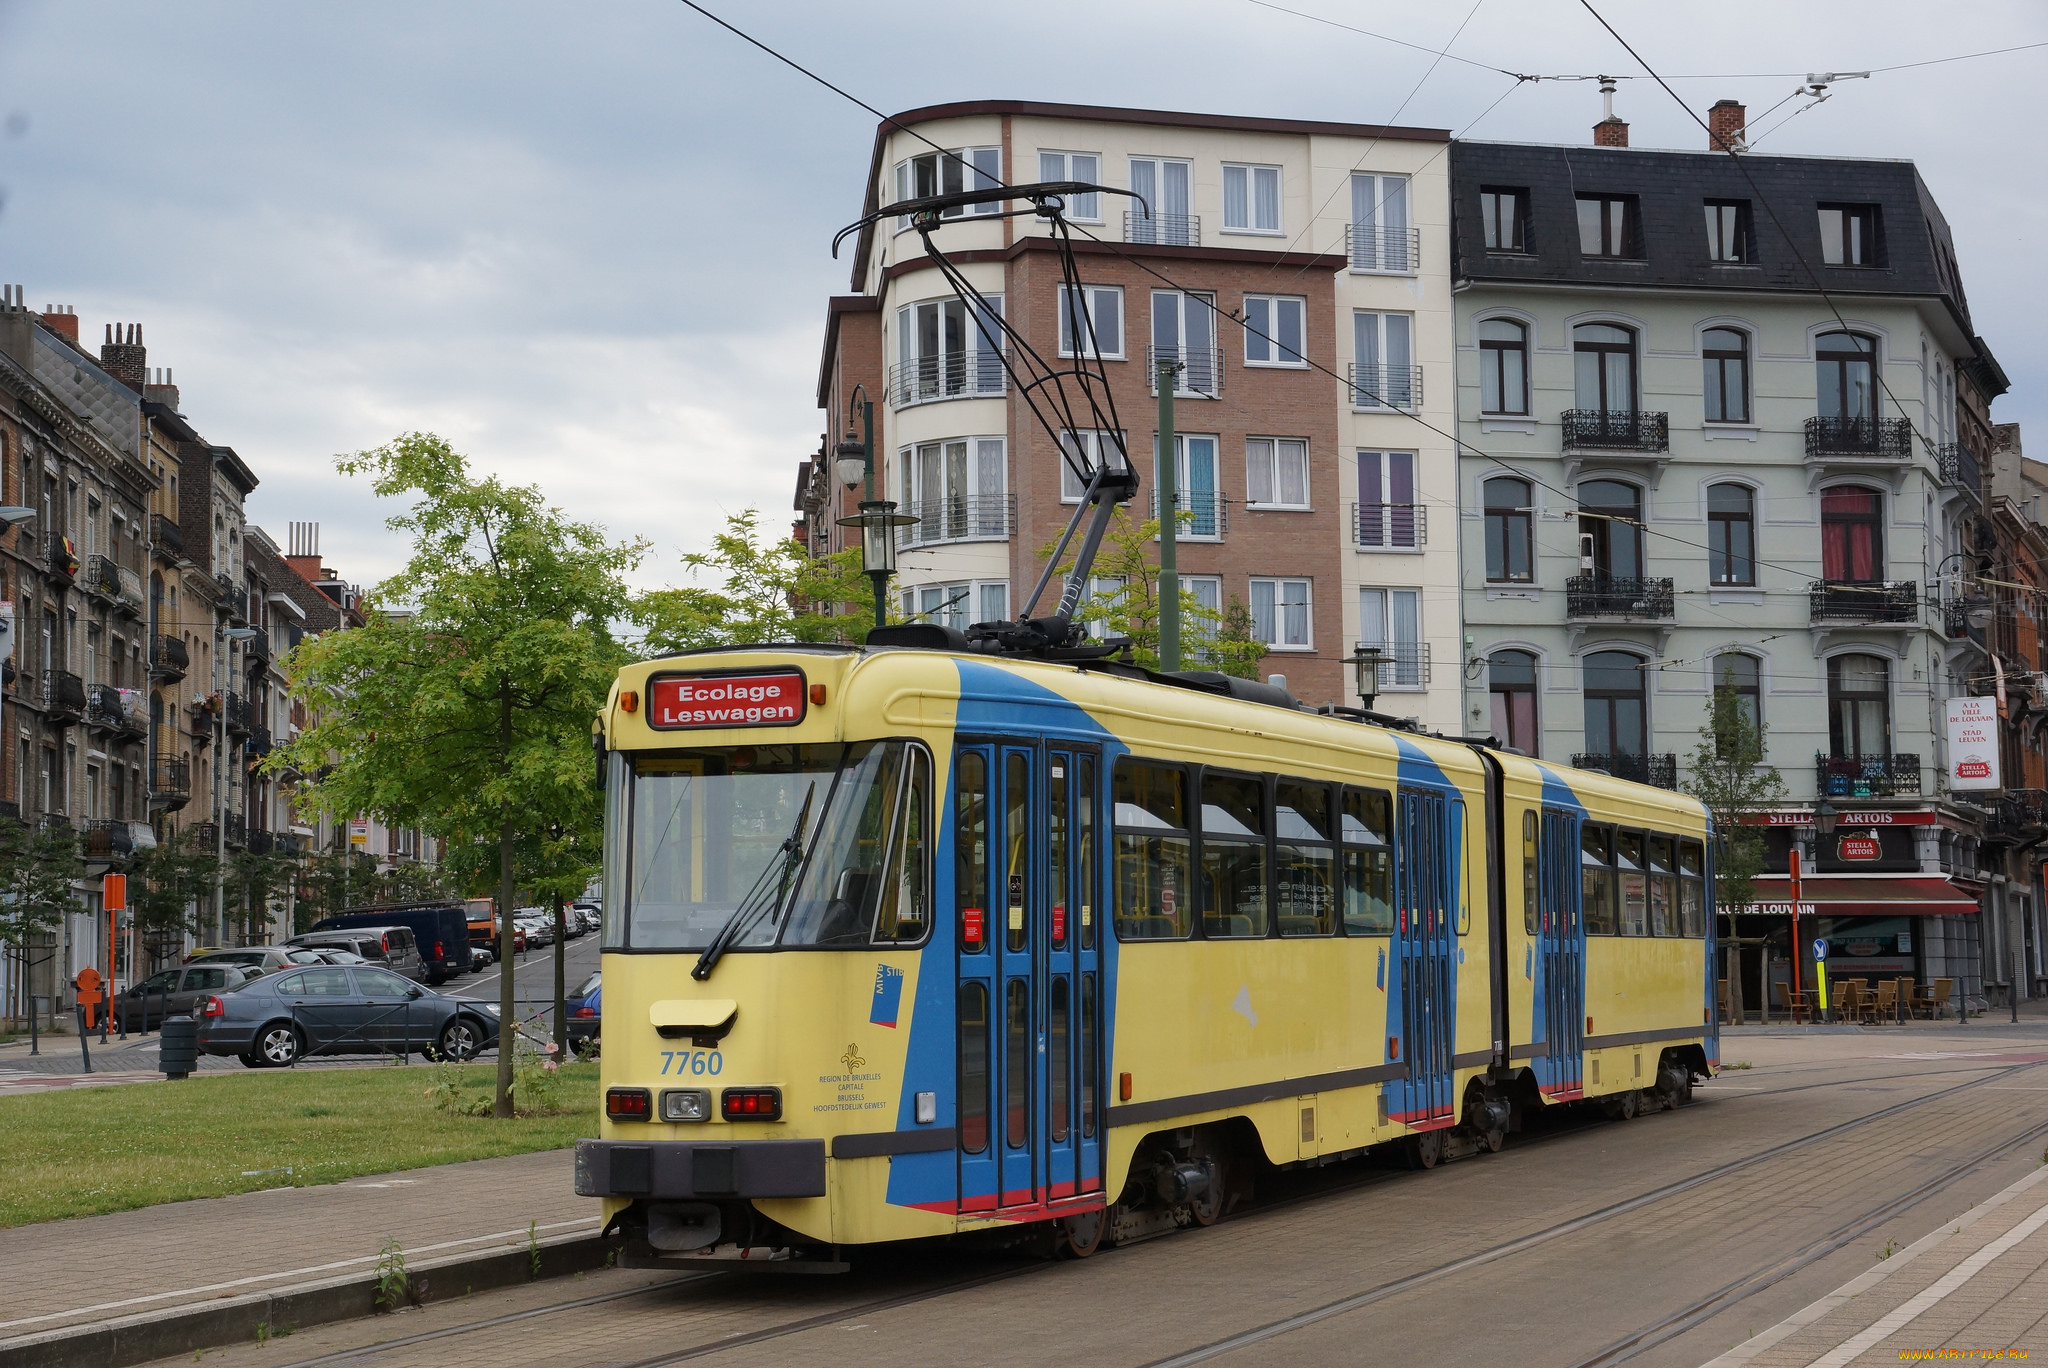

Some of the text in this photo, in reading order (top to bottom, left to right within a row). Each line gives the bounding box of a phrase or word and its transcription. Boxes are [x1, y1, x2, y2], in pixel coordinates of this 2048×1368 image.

[678, 684, 781, 703] Ecolage
[664, 703, 794, 723] Leswagen
[1770, 813, 1893, 824] STELLA ARTOIS
[1743, 904, 1760, 914] DE
[887, 968, 904, 976] STIB
[660, 1051, 723, 1076] 7760
[819, 1073, 881, 1083] REGION DE BRUXELLES
[838, 1083, 864, 1091] CAPITALE
[837, 1093, 865, 1102] BRUSSELS
[813, 1102, 886, 1112] HOOFDSTEDELIJK GEWEST
